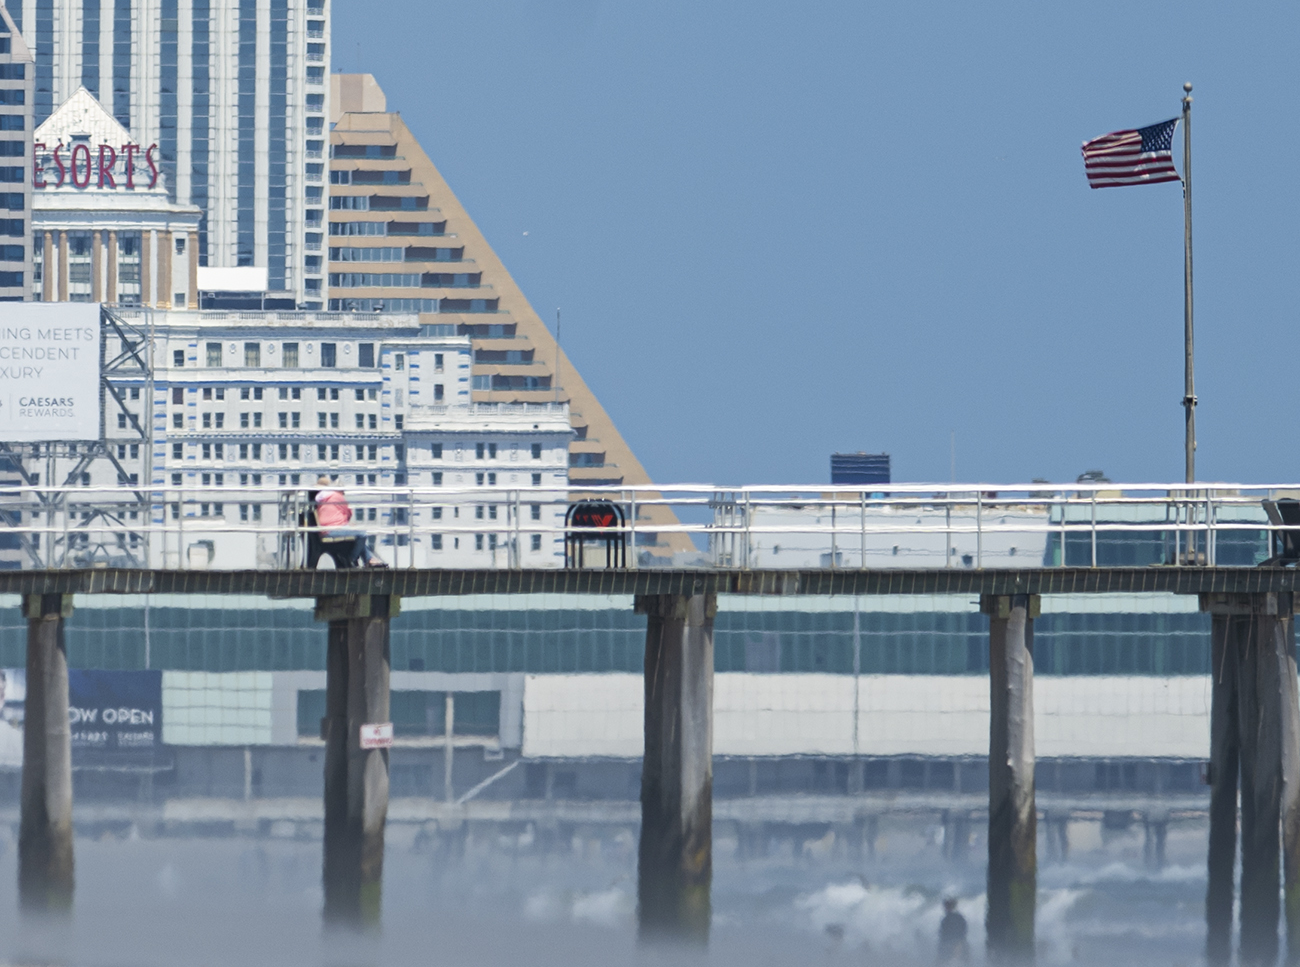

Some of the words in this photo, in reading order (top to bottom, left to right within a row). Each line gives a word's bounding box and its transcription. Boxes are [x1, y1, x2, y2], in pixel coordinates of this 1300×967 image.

[33, 143, 158, 189] ESORTS
[37, 327, 94, 341] MEETS
[19, 397, 74, 407] CAESARS
[19, 408, 74, 417] REWARDS
[67, 706, 98, 723] OW
[102, 707, 154, 725] OPEN
